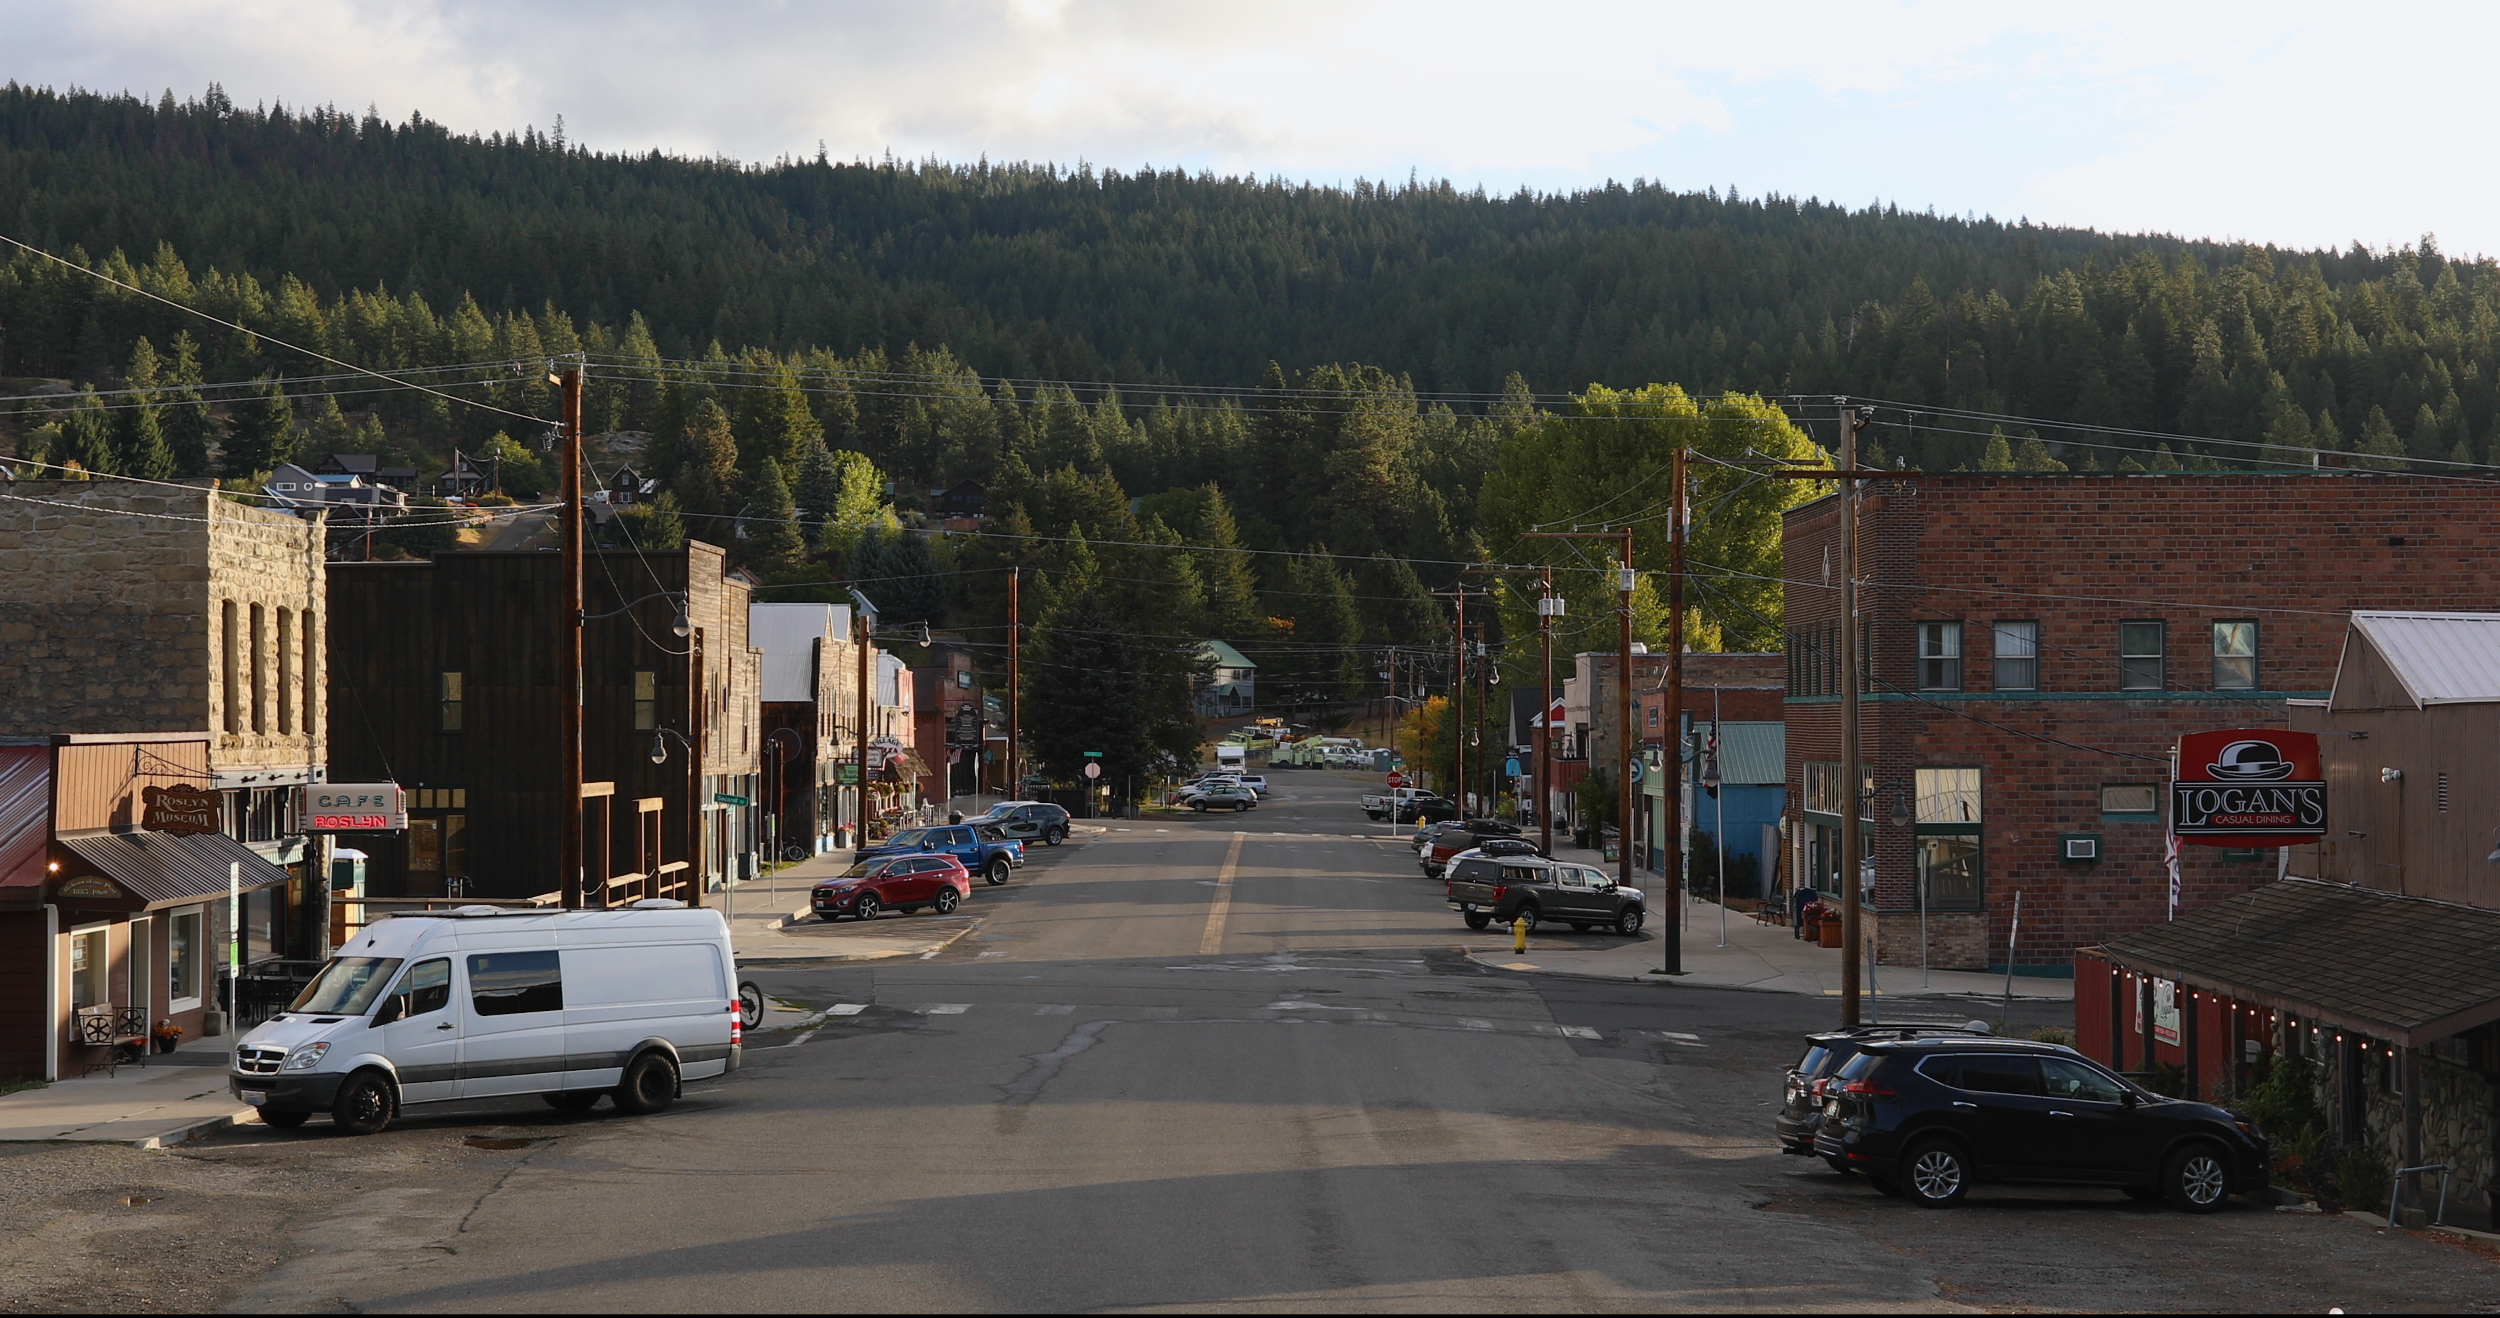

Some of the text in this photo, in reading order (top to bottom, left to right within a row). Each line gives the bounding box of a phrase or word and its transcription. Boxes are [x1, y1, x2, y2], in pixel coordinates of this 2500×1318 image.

[1387, 776, 1402, 784] STOP
[155, 794, 210, 810] ROSLYN
[318, 795, 384, 807] CAFE
[717, 795, 739, 804] Second
[2178, 788, 2323, 826] LOGAN'S
[152, 811, 210, 827] MUSEUM
[315, 815, 387, 828] ROSLYN
[2215, 815, 2291, 824] CASUAL DINING
